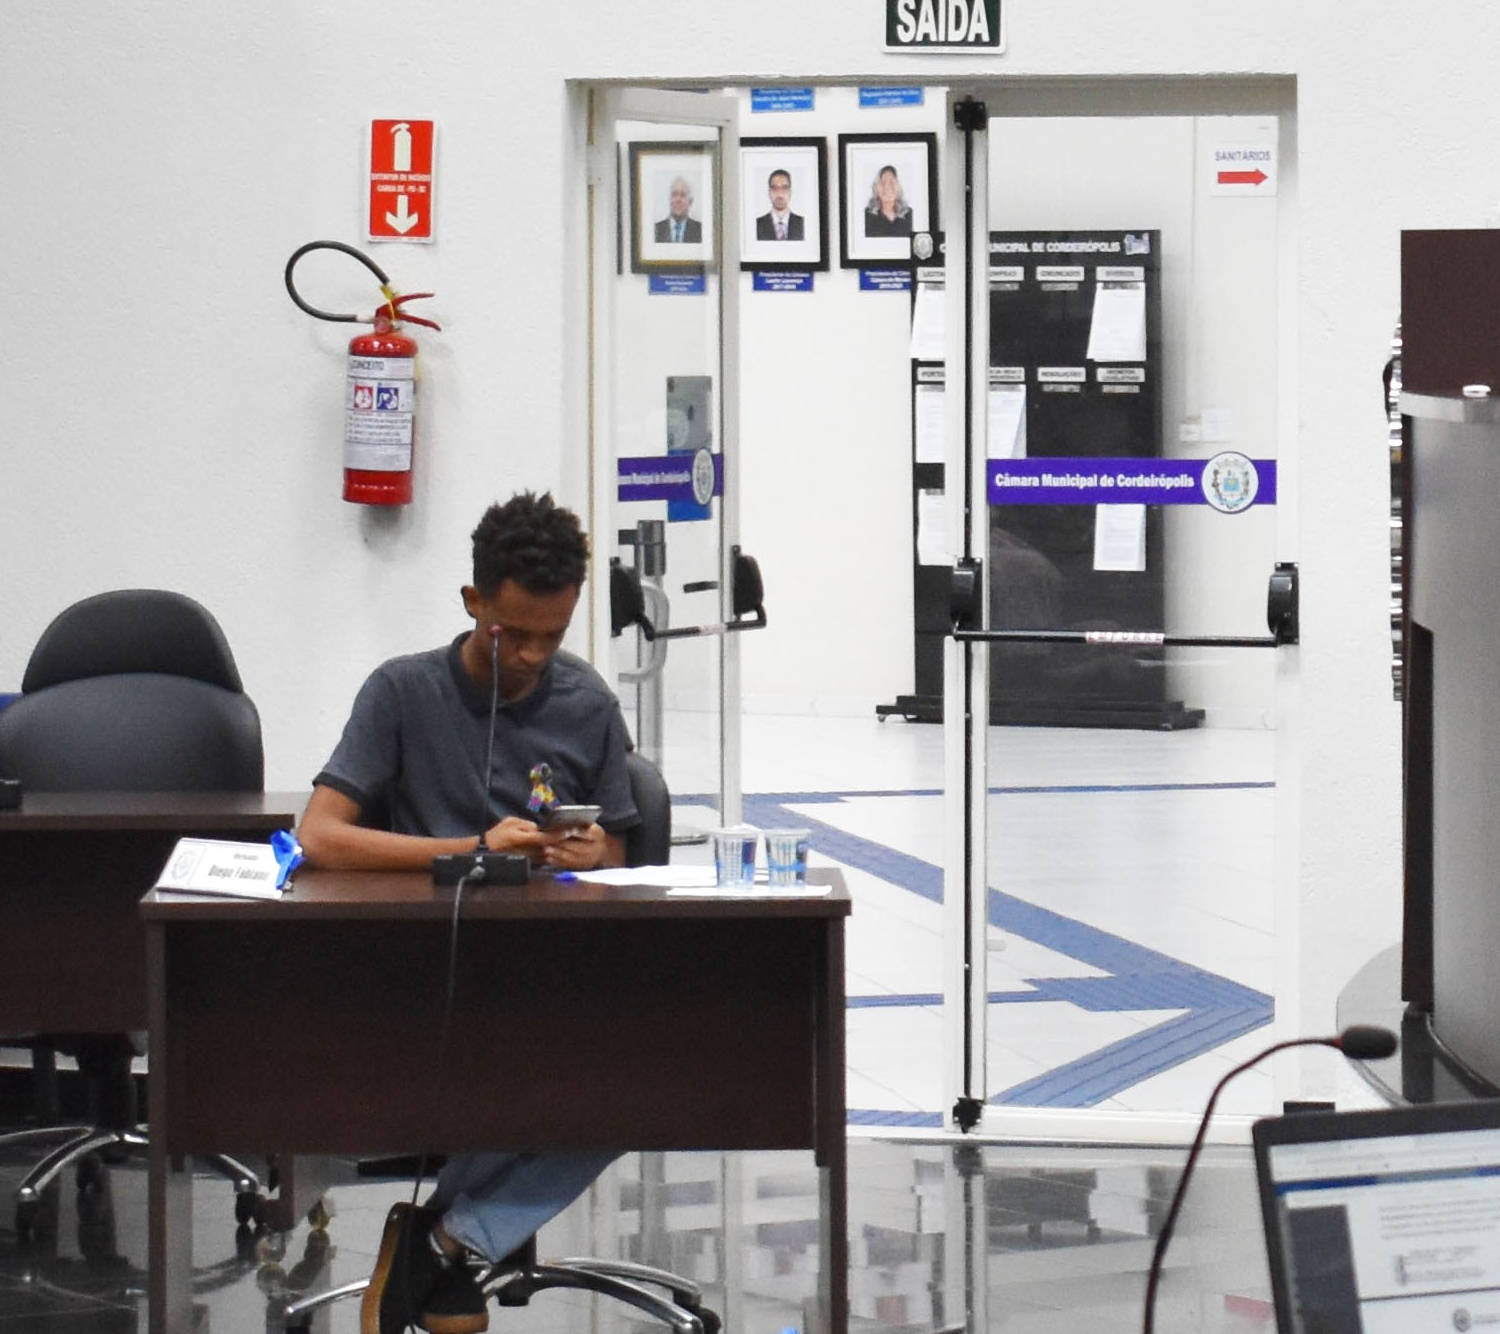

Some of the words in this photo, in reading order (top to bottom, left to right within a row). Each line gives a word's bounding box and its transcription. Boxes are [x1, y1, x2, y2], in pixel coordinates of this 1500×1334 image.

[995, 473, 1040, 487] Câmara
[1042, 473, 1098, 489] Municipal
[1100, 473, 1115, 487] de
[1116, 473, 1195, 489] Cordeirópolis
